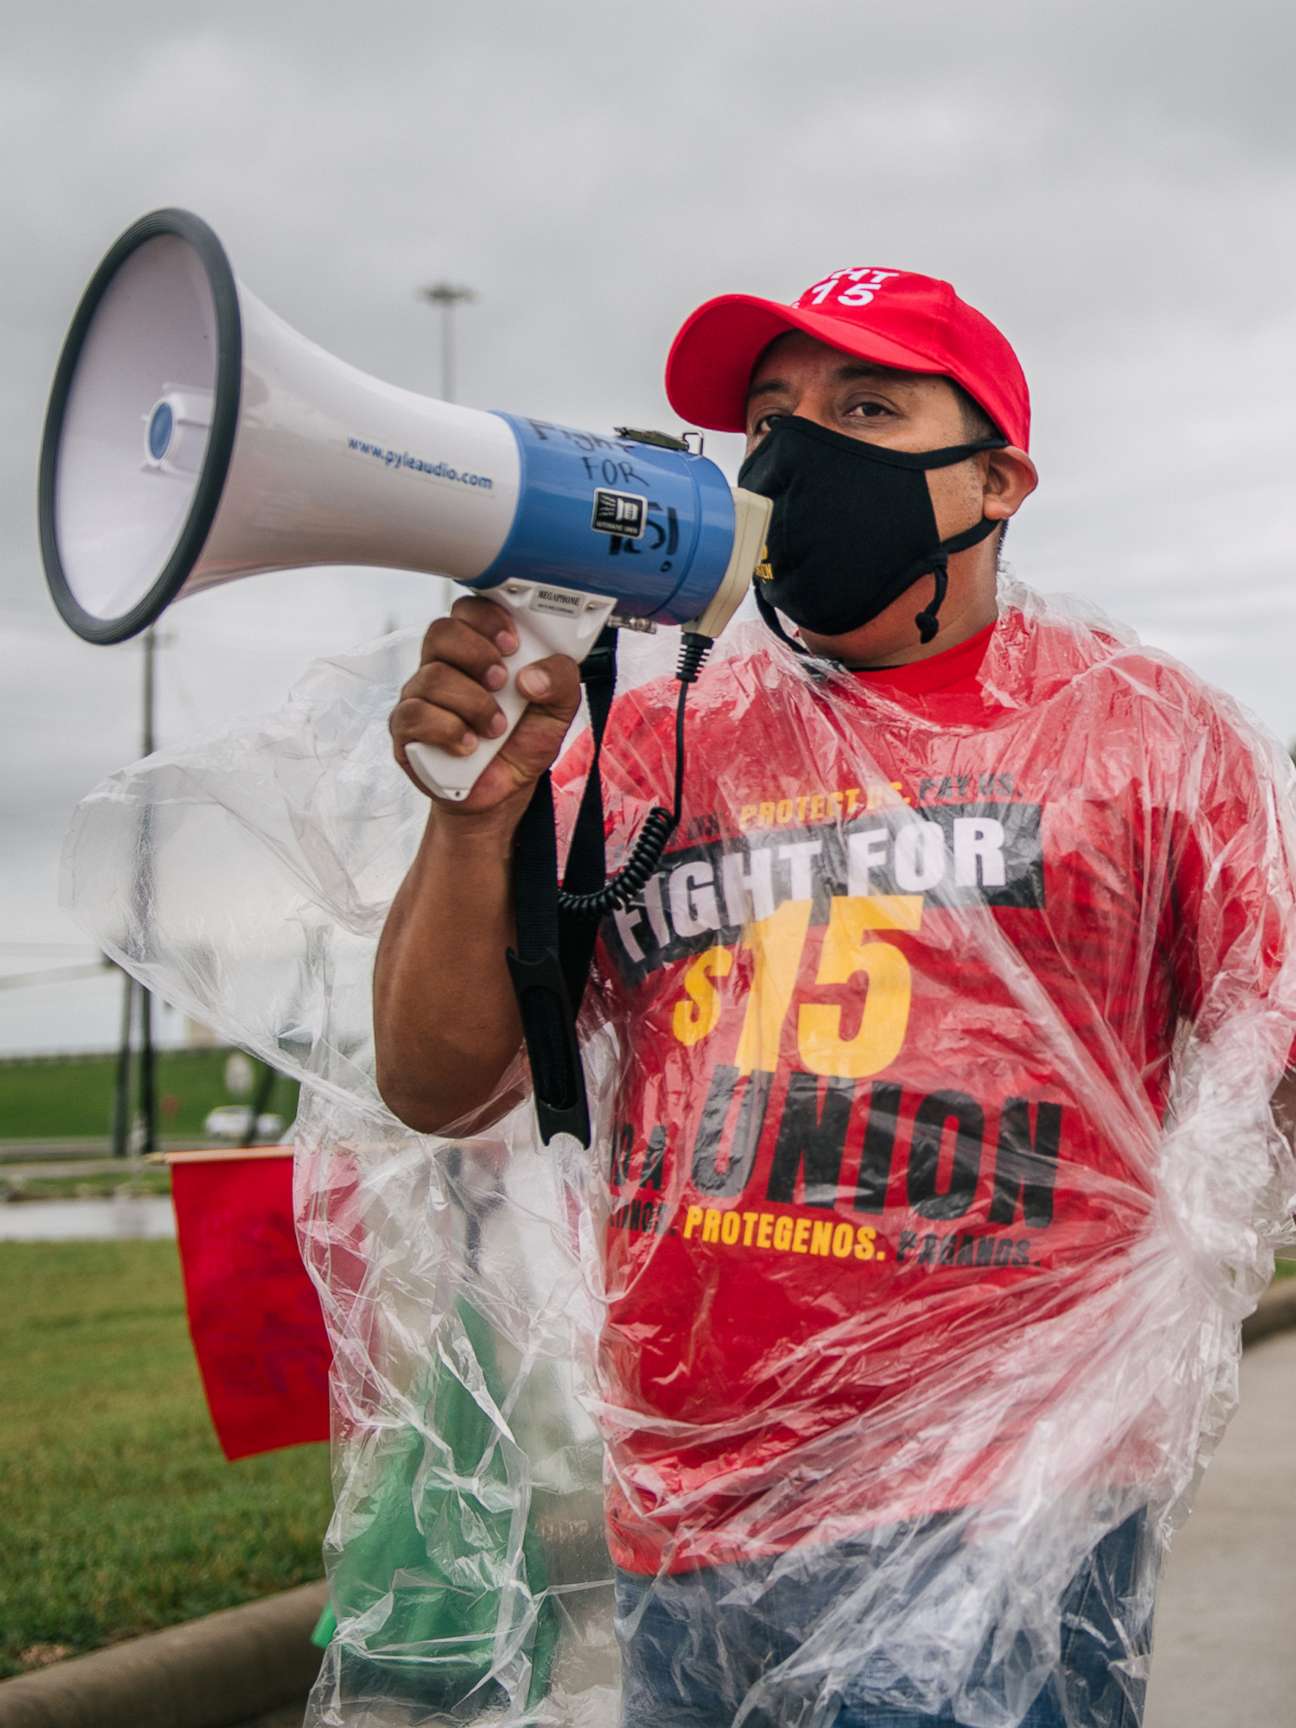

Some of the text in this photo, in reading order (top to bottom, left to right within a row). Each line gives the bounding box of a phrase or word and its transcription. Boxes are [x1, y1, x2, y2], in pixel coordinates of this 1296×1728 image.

[791, 279, 882, 308] 15
[347, 437, 494, 490] www.pyleaudio.com
[581, 456, 650, 487] FOR
[612, 816, 1007, 964] FIGHT FOR
[690, 1064, 1063, 1229] UNION
[682, 1204, 887, 1262] PROTEGENOS.
